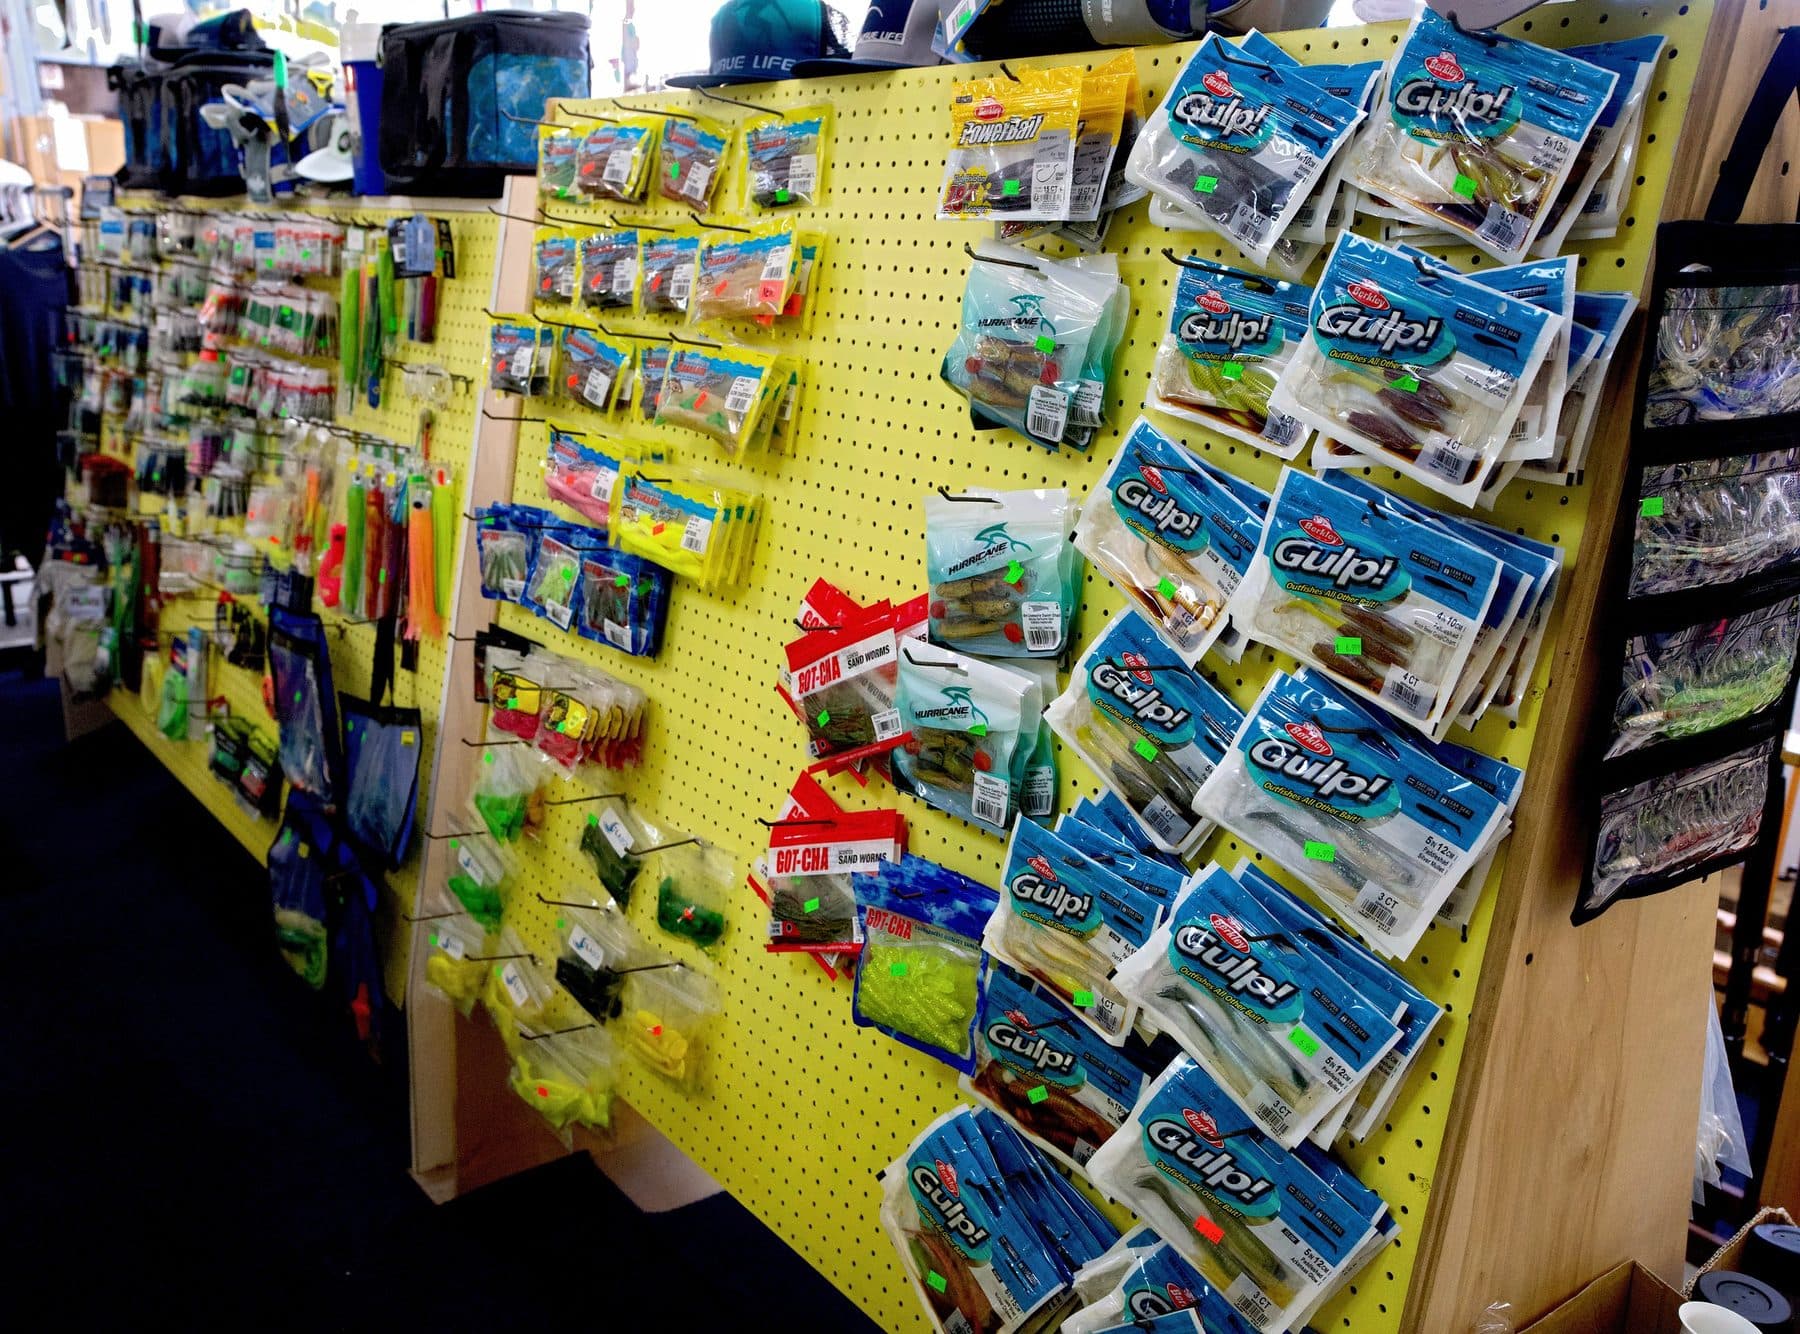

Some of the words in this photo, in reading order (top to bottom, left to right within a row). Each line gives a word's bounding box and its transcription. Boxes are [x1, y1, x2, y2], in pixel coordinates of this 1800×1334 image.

[880, 32, 903, 41] LIFE
[752, 55, 797, 71] LIFE
[1428, 59, 1462, 79] Berkley
[1174, 91, 1270, 136] Gulp!
[1395, 79, 1513, 121] Gulp!
[959, 112, 1044, 146] PowerBait
[1255, 215, 1265, 226] CT
[1500, 210, 1505, 220] 5
[1505, 213, 1518, 225] CT
[1199, 297, 1228, 313] Berkley
[1352, 286, 1386, 308] Berkley
[1178, 312, 1269, 349] Gulp!
[1316, 304, 1444, 352] Gulp!
[1329, 349, 1367, 365] Outfishes
[1368, 356, 1379, 366] All
[1452, 440, 1462, 451] CT
[1143, 467, 1166, 493] Berkley
[1115, 477, 1202, 541] Gulp!
[1304, 521, 1338, 543] Berkley
[948, 542, 1009, 576] HURRICANE
[1274, 538, 1400, 588] Gulp!
[1286, 582, 1324, 598] Outfishes
[1325, 589, 1336, 600] All
[1336, 592, 1358, 605] Other
[1359, 598, 1379, 610] Bait!
[798, 655, 841, 694] GOT-CHA
[847, 655, 865, 670] SAND
[865, 644, 890, 663] WORMS
[1403, 672, 1409, 680] 4
[1408, 675, 1419, 687] CT
[867, 683, 892, 709] WORMS
[1091, 662, 1192, 733] Gulp!
[914, 706, 970, 719] HURRICANE
[1095, 699, 1124, 722] Outfishes
[1123, 716, 1132, 727] All
[1131, 720, 1149, 738] Other
[1291, 725, 1329, 753] Berkley
[1249, 739, 1392, 804] Gulp!
[1160, 804, 1166, 812] 3
[1166, 809, 1175, 821] CT
[1263, 780, 1303, 804] Outfishes
[1302, 796, 1315, 808] All
[1314, 801, 1339, 817] Other
[1339, 808, 1361, 824] Bait!
[776, 847, 829, 874] GOT-CHA
[838, 854, 858, 865] SAND
[859, 852, 887, 864] WORMS
[1437, 842, 1455, 860] 12CM
[1011, 873, 1093, 919] Gulp!
[1378, 892, 1385, 901] 3
[1385, 896, 1399, 909] CT
[866, 907, 912, 941] GOT-CHA
[1213, 918, 1248, 951] Berkley
[1174, 925, 1299, 1009] Gulp!
[1104, 999, 1115, 1010] CT
[1180, 966, 1215, 992] Outfishes
[1213, 987, 1225, 1001] All
[1225, 994, 1246, 1015] Other
[1245, 1007, 1264, 1025] Bait!
[987, 1022, 1076, 1074] Gulp!
[1335, 1064, 1351, 1082] 12CM
[1273, 1100, 1279, 1108] 3
[1279, 1104, 1292, 1118] CT
[1148, 1120, 1275, 1206] Gulp!
[1156, 1161, 1192, 1188] Outfishes
[1190, 1181, 1202, 1196] All
[1200, 1189, 1223, 1210] Other
[1222, 1201, 1243, 1219] Bait!
[912, 1165, 989, 1248] Gulp!
[1313, 1255, 1330, 1274] 12CM
[1253, 1291, 1259, 1299] 3
[1259, 1296, 1272, 1309] CT
